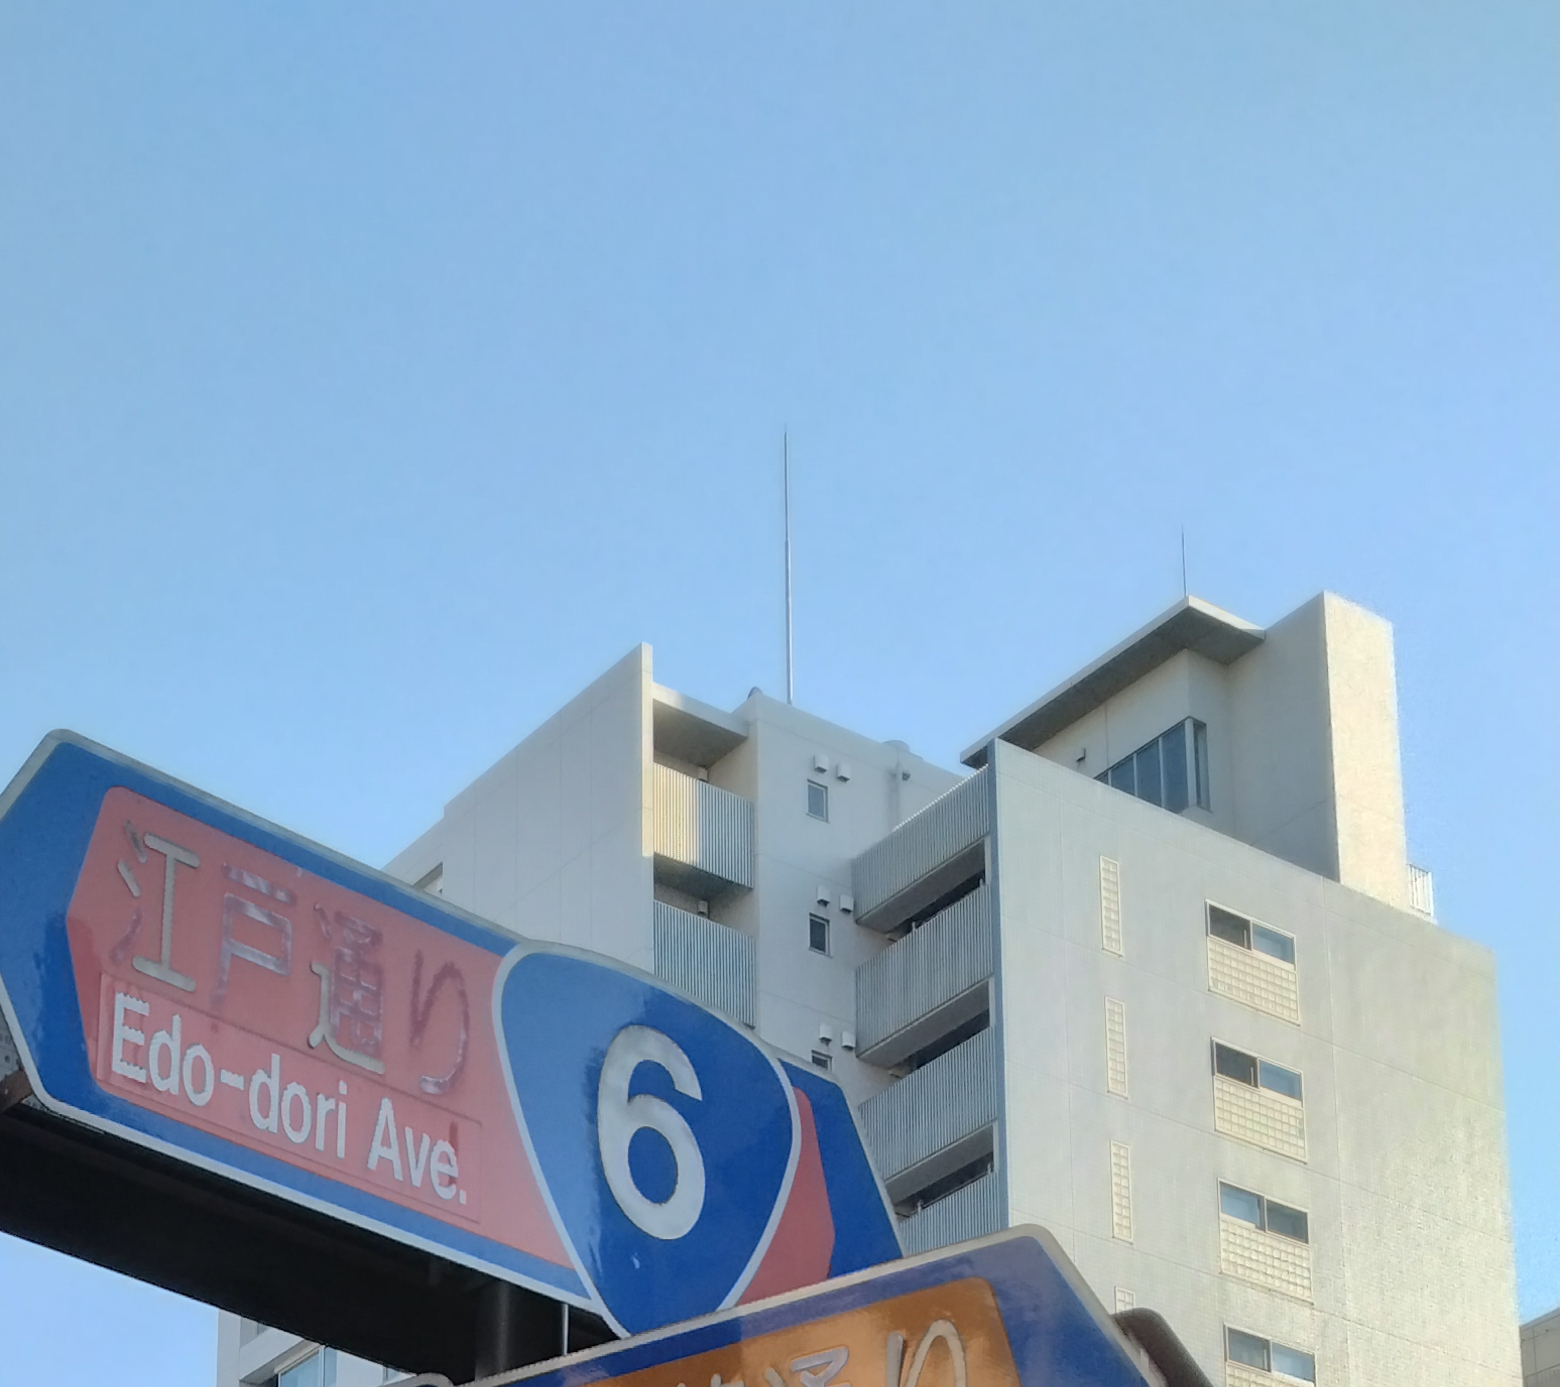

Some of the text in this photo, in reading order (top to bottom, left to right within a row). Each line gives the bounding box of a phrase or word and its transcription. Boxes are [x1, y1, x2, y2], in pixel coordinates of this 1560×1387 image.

[110, 818, 470, 1095] 江戸通り
[110, 988, 350, 1160] Edo-dori
[367, 1112, 469, 1205] Ave.
[597, 1023, 706, 1241] 6
